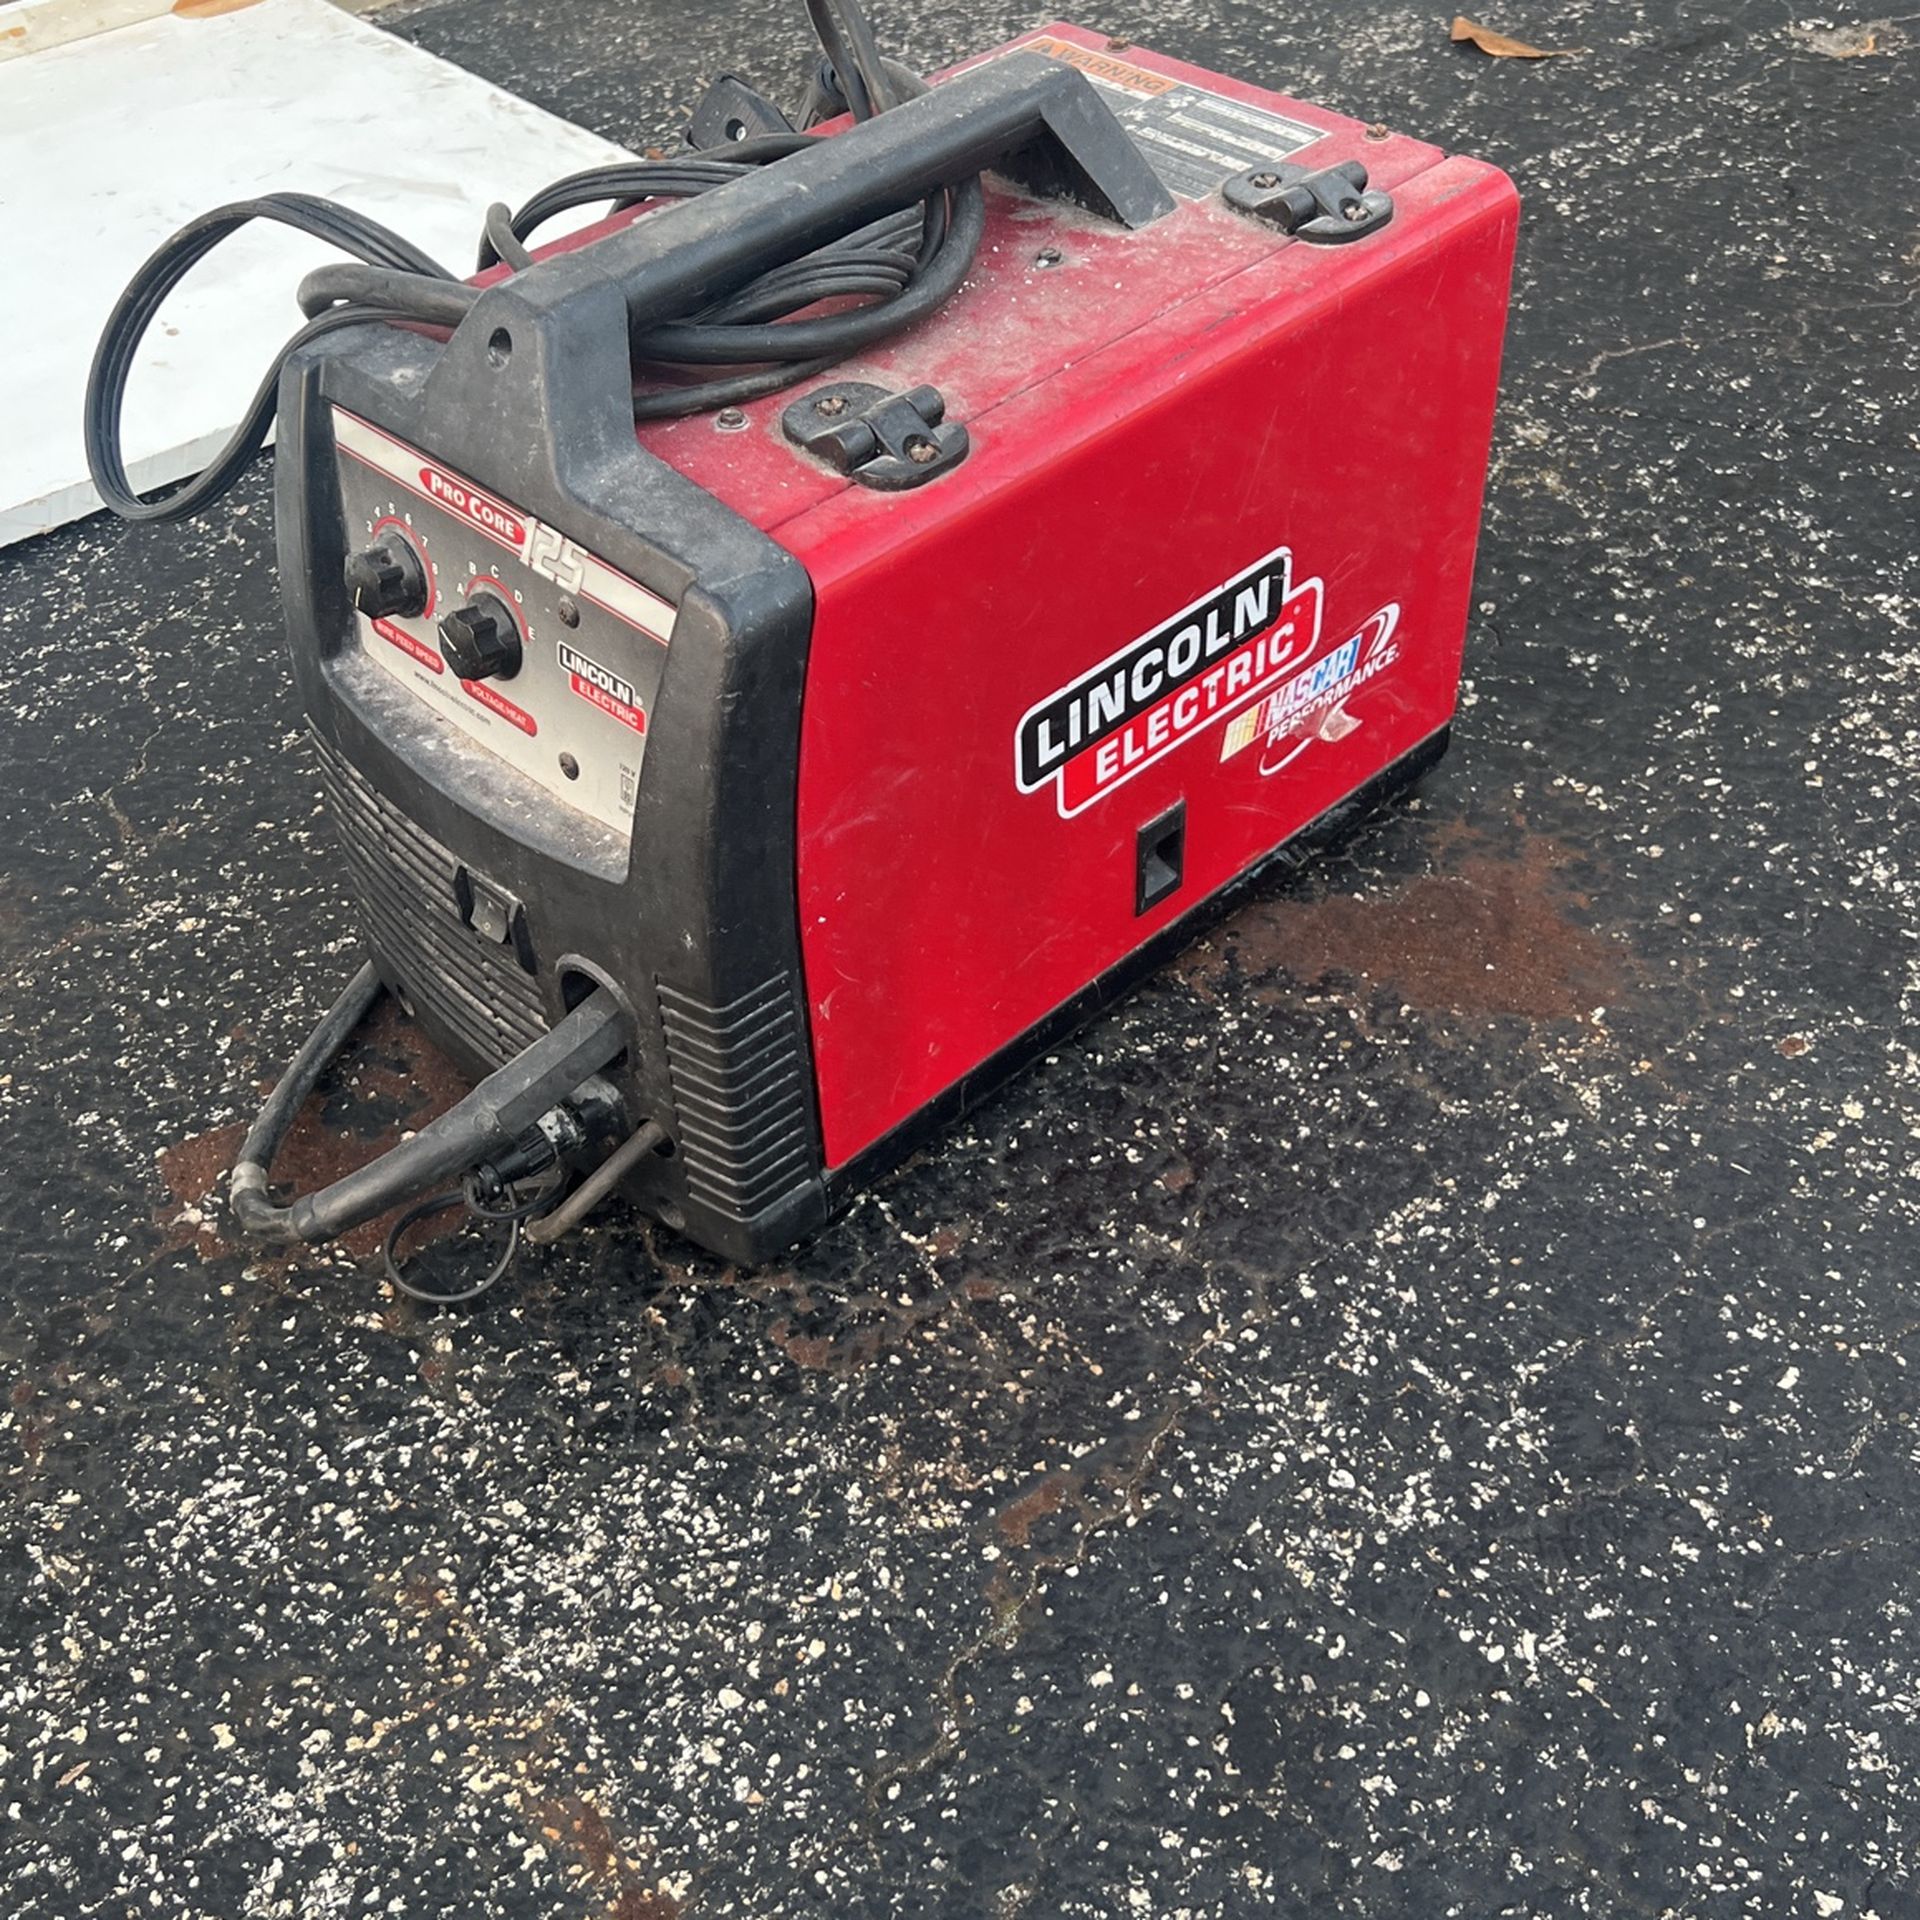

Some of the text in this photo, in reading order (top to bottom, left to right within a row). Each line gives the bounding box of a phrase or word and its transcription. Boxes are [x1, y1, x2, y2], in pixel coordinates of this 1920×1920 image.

[1059, 48, 1165, 92] WARNING
[374, 506, 381, 518] 4
[388, 502, 395, 515] 5
[405, 513, 412, 526] 6
[421, 535, 428, 548] 7
[520, 516, 589, 595] 125
[468, 561, 477, 575] B
[490, 564, 500, 579] C
[456, 582, 465, 597] A
[514, 589, 523, 604] D
[528, 625, 536, 641] E
[562, 647, 630, 705] LINCOLN
[1038, 575, 1271, 768] LINCOLN
[579, 681, 638, 727] ELECTRIC
[1096, 622, 1295, 786] ELECTRIC
